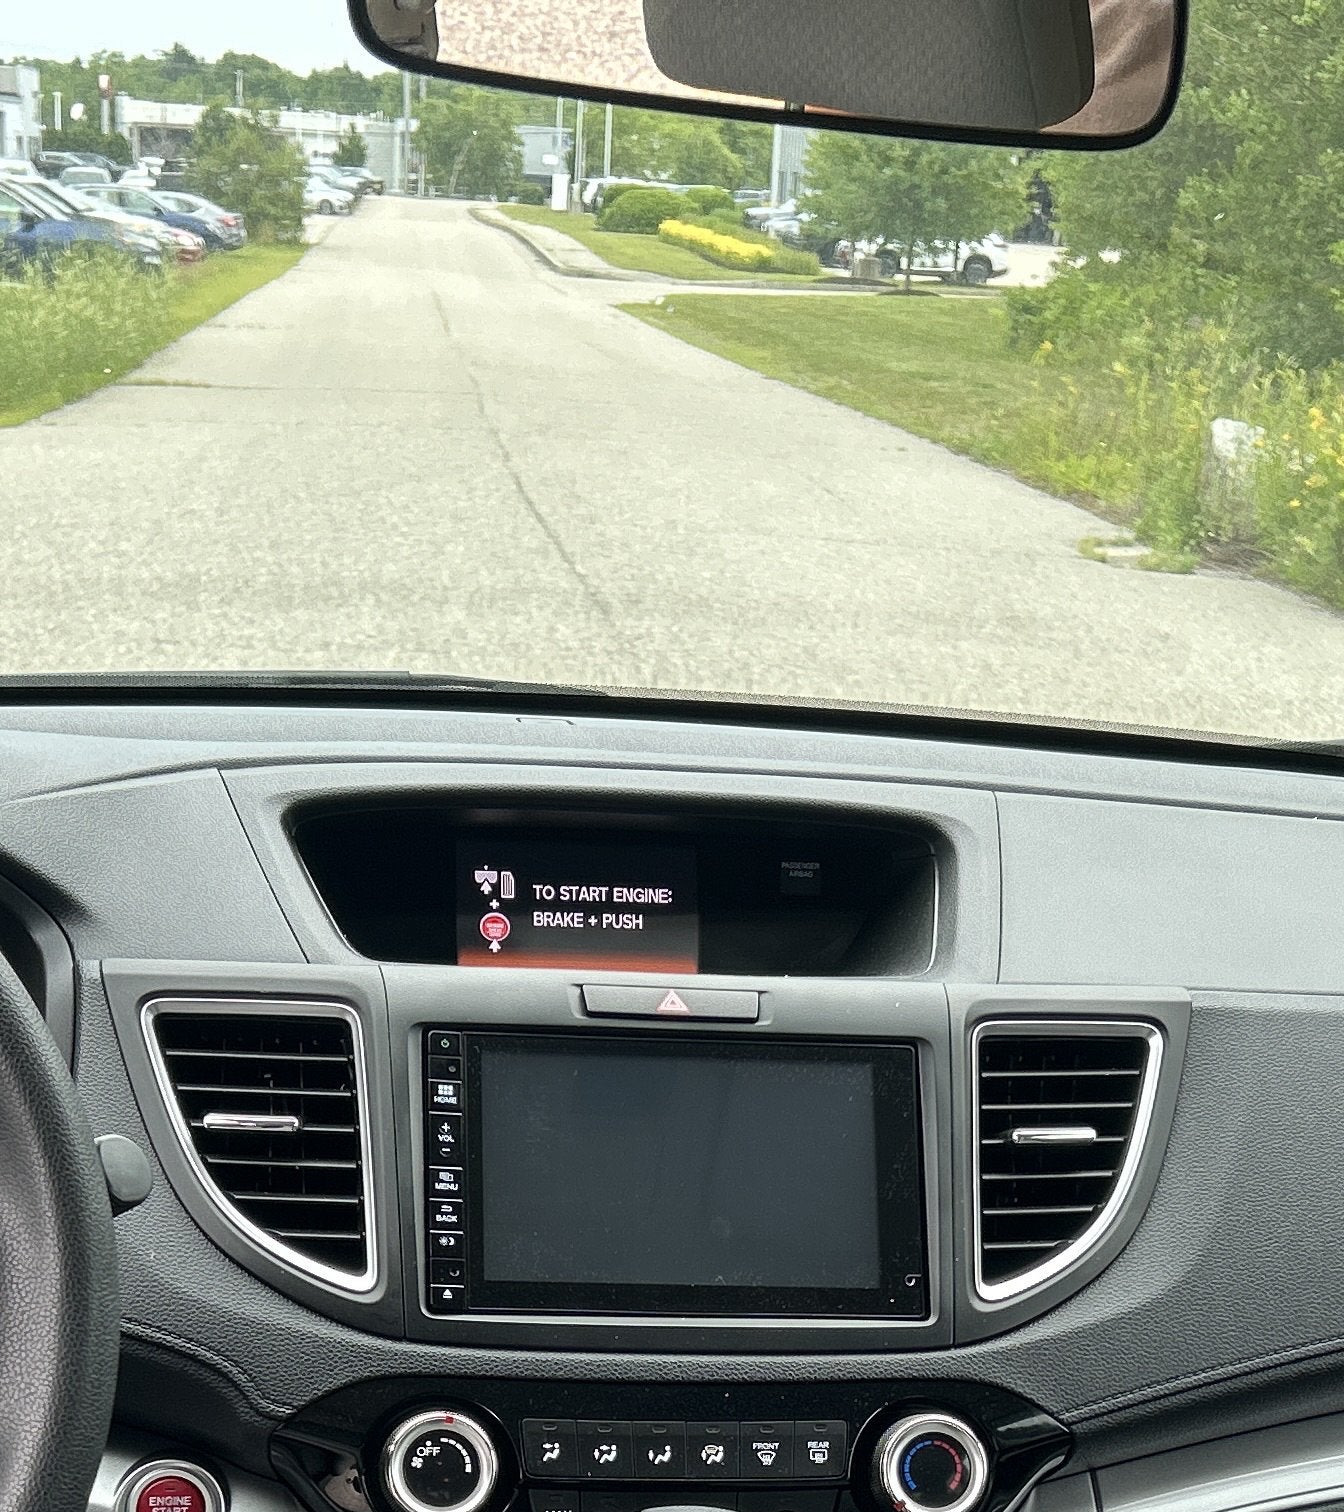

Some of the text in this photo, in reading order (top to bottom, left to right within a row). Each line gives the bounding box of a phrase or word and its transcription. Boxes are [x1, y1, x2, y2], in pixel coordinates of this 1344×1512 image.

[532, 884, 672, 904] TO START ENGINE:
[533, 912, 584, 928] BRAKE
[602, 914, 643, 930] PUSH
[438, 1134, 455, 1142] VOL
[416, 1447, 440, 1456] OFF
[149, 1496, 192, 1506] ENGINE
